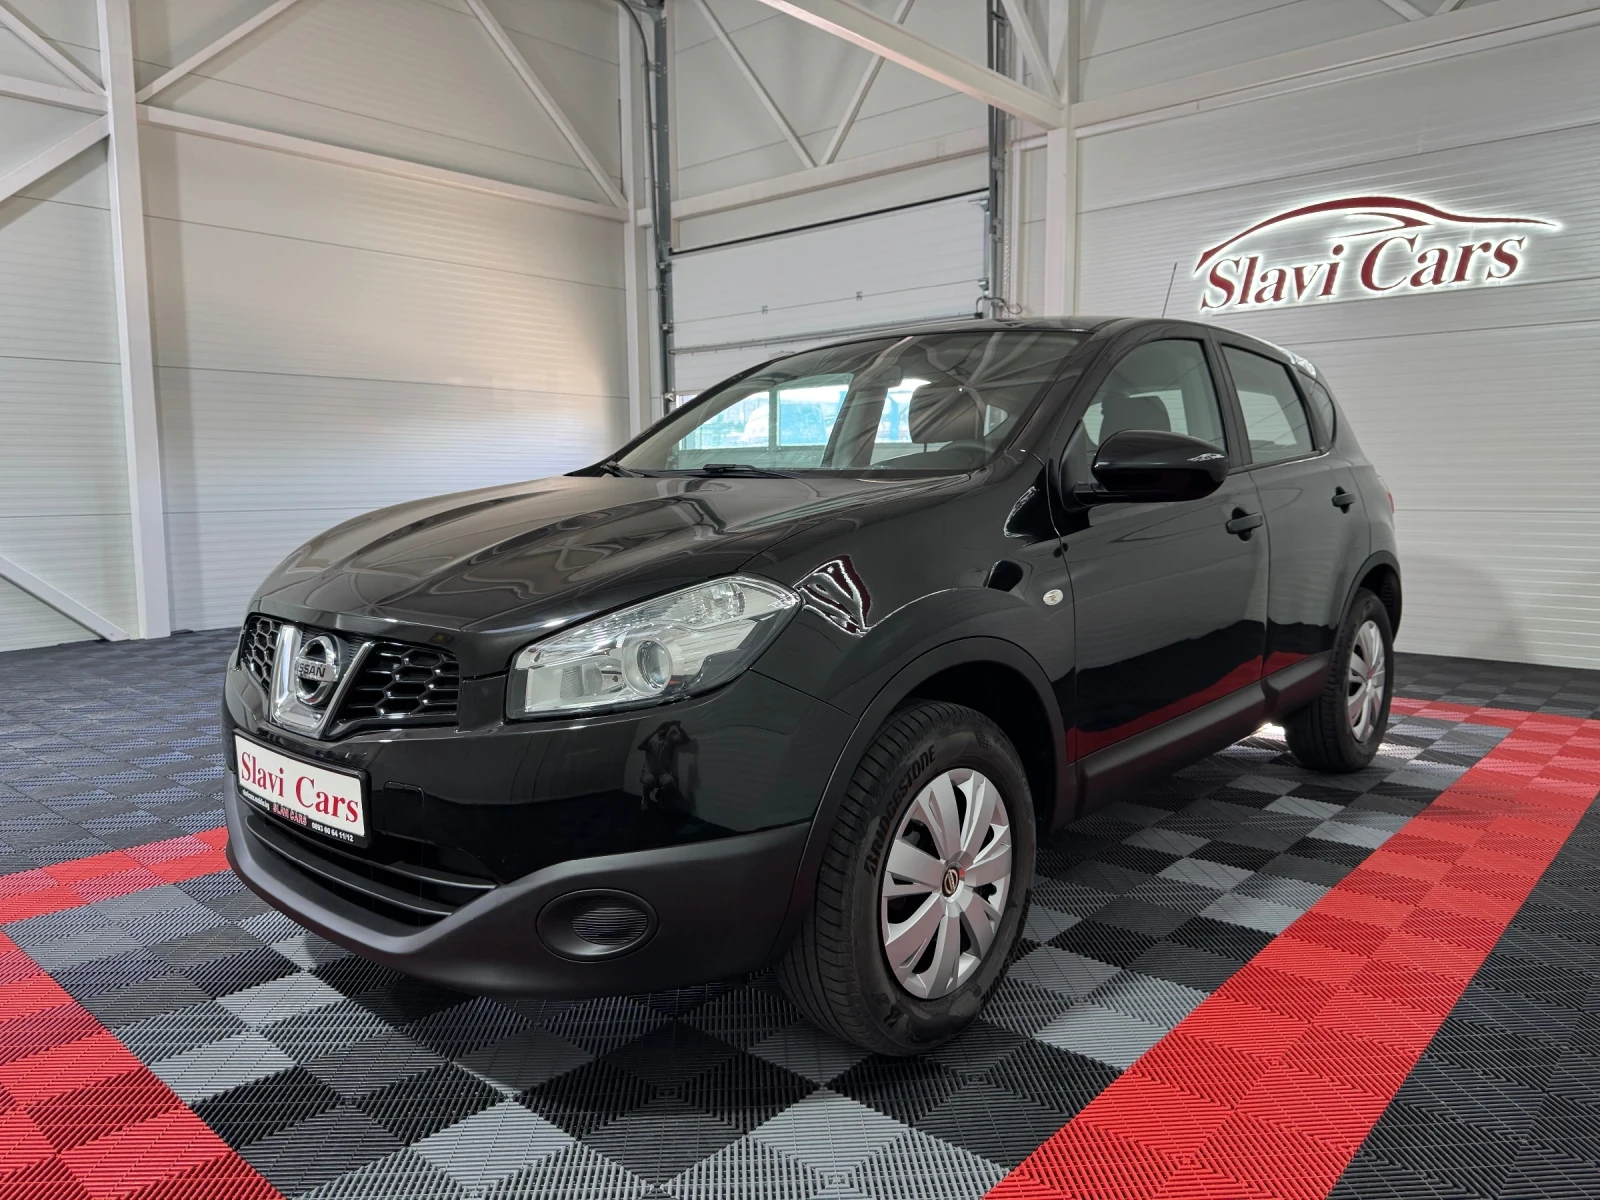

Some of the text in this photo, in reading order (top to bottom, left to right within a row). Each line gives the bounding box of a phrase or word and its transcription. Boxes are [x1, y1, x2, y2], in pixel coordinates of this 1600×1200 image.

[1200, 233, 1526, 310] Slavi Cars
[241, 751, 359, 823] Slavi Cars
[273, 802, 308, 826] SLAVI CARS
[864, 744, 936, 877] BRIDGESTONE
